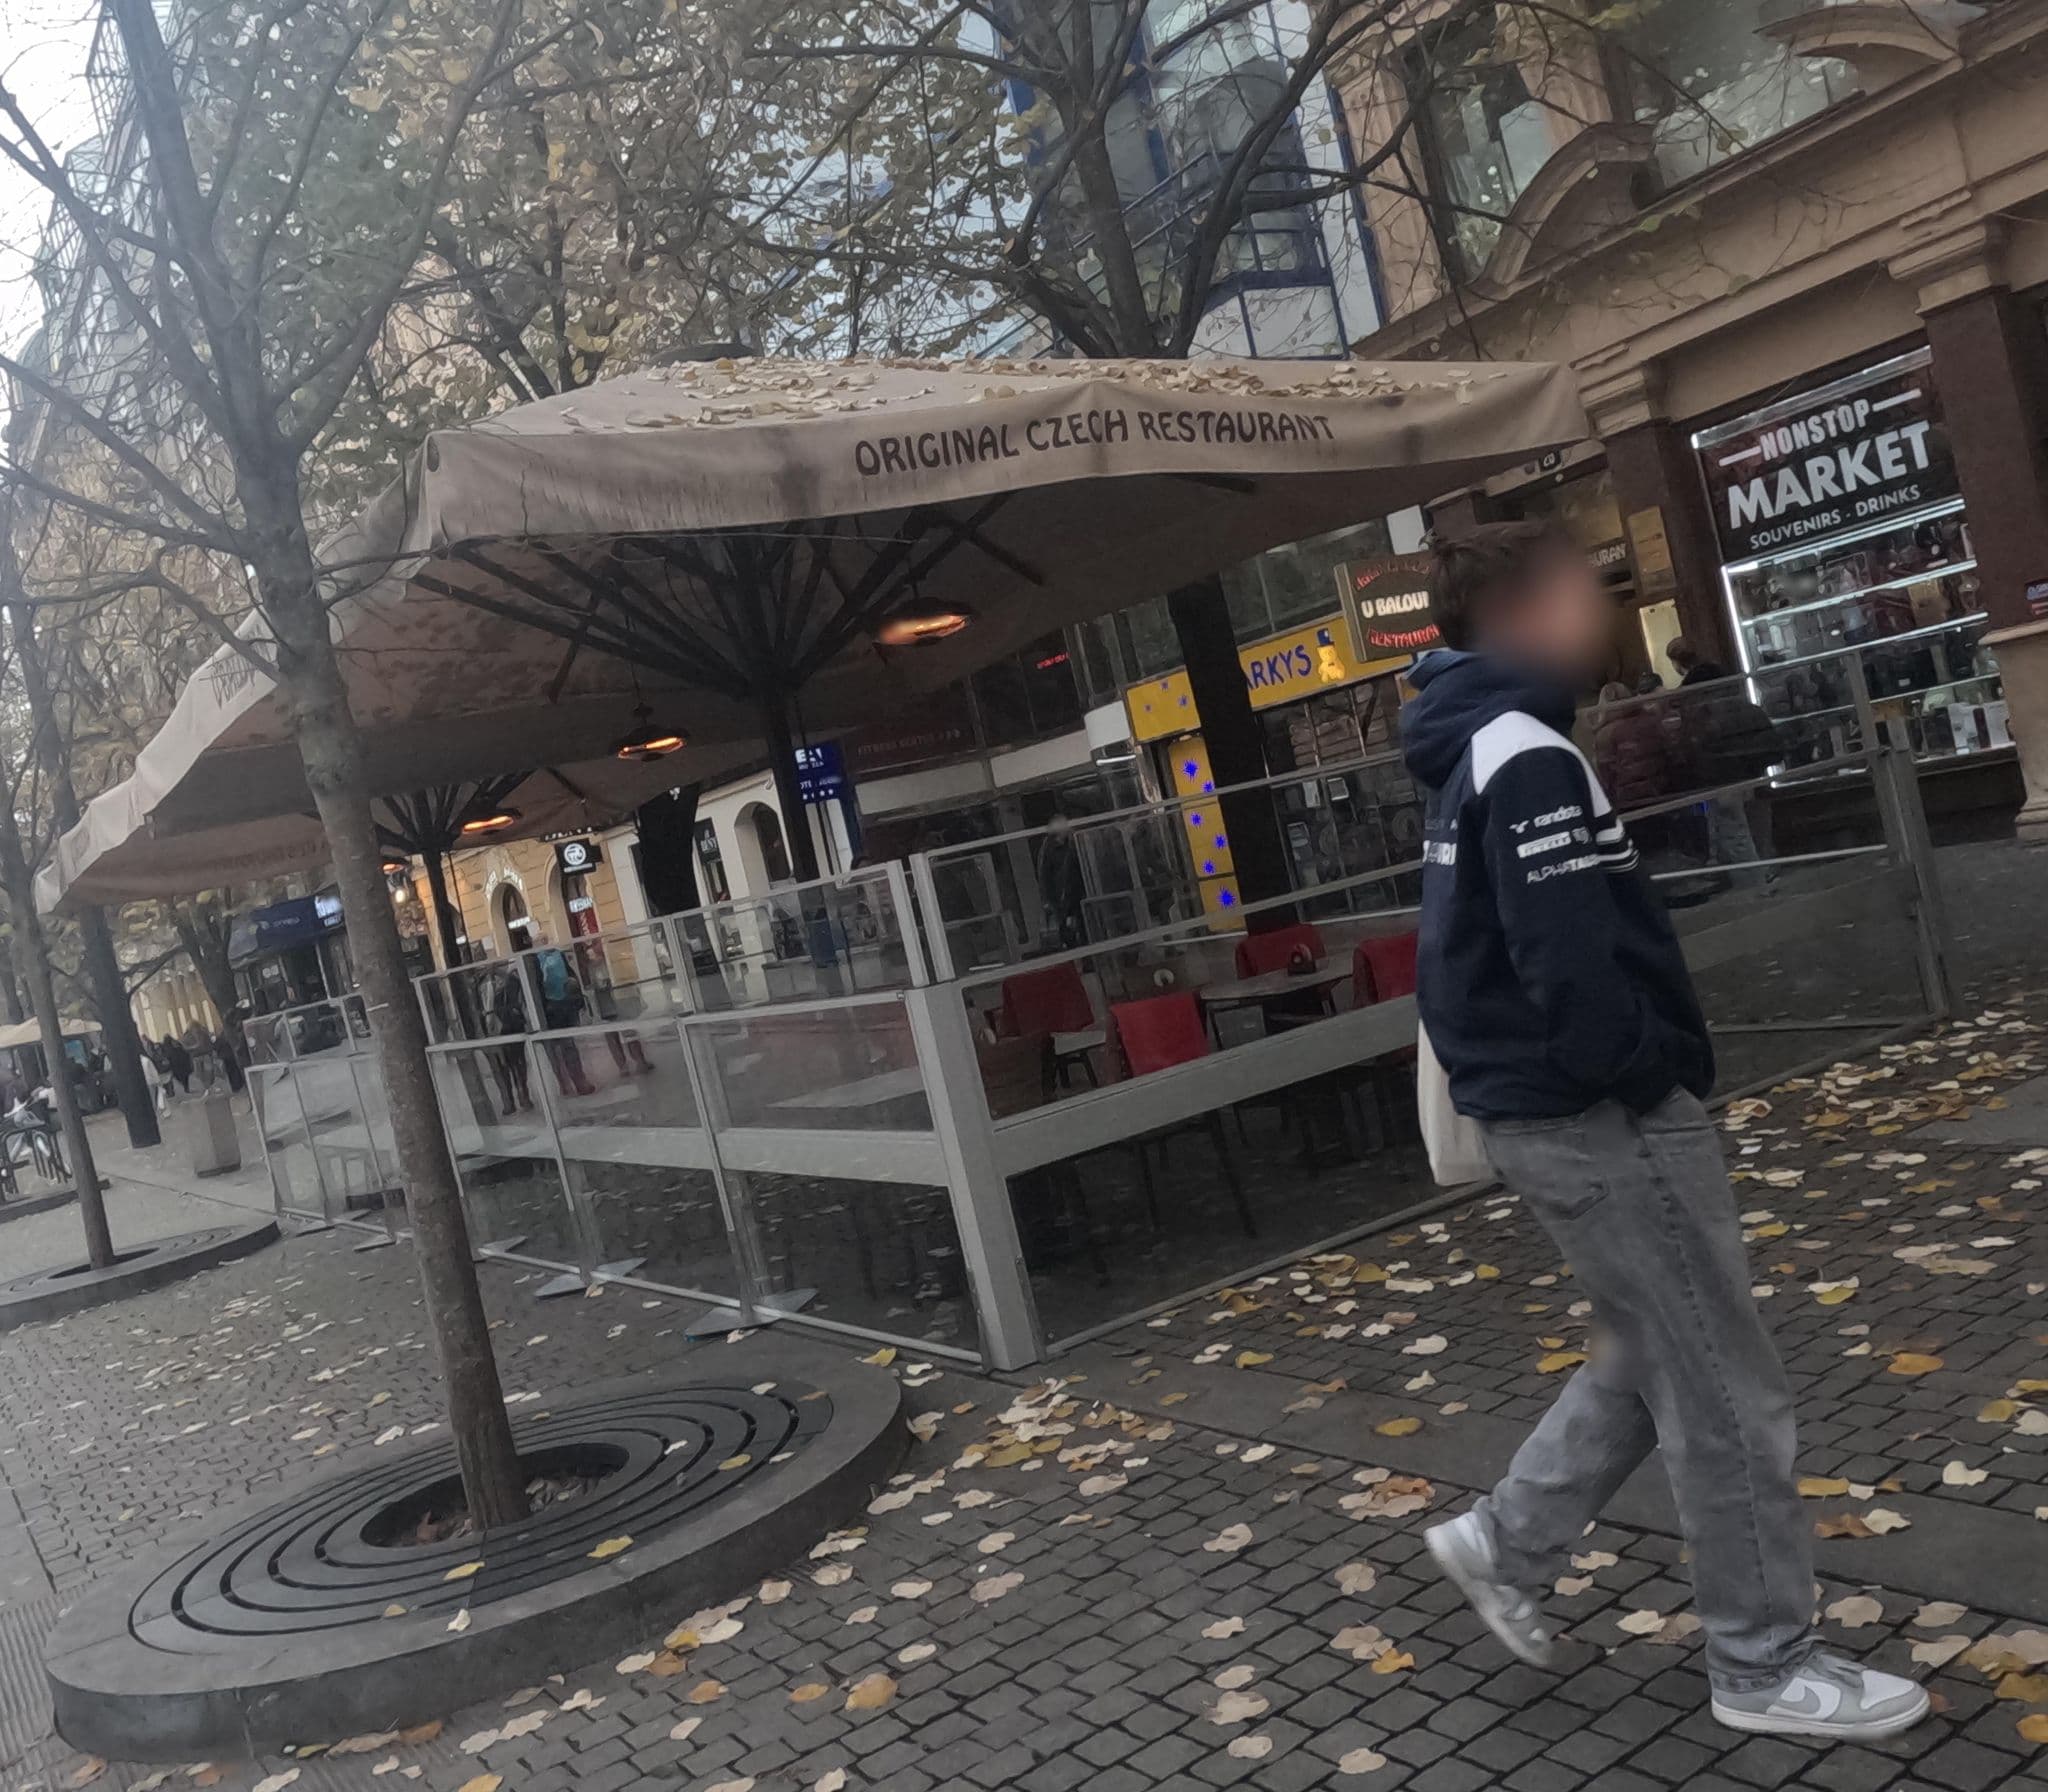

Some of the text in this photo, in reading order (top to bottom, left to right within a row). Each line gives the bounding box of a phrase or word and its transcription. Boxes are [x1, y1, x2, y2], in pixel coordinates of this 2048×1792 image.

[855, 409, 1335, 476] ORIGINAL CZECH RESTAURANT
[1760, 399, 1870, 461] NONSTOP
[1727, 421, 1930, 529] MARKET
[1750, 510, 1841, 550] SOUVENIRS
[1855, 484, 1920, 519] DRINKS
[1361, 600, 1374, 618] U
[1247, 646, 1312, 690] RKYS
